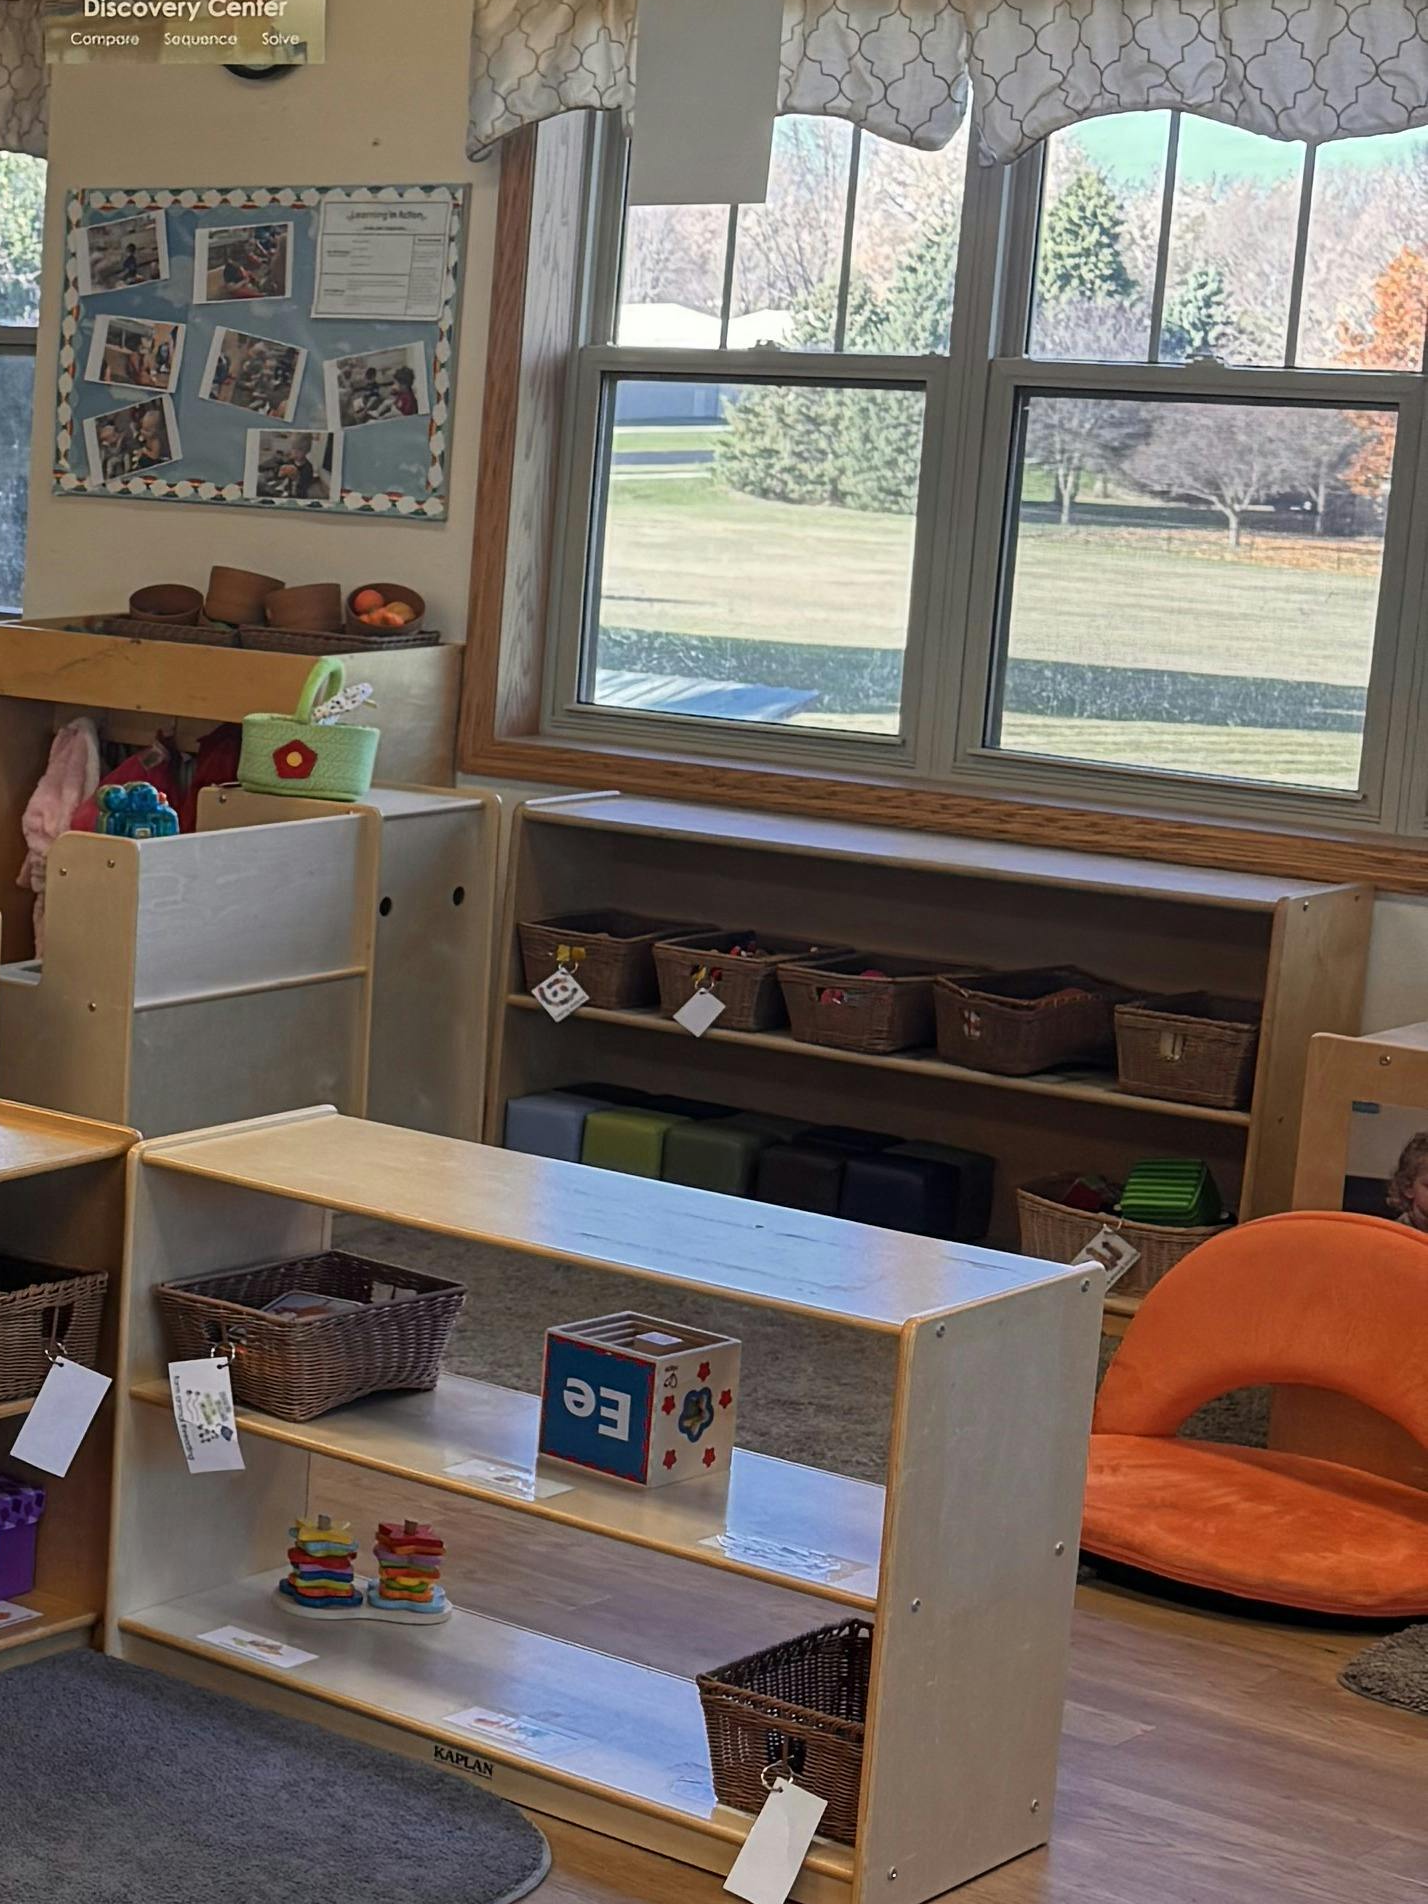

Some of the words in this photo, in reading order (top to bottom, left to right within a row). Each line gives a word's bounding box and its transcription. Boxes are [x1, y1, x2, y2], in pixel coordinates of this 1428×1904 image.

[70, 31, 140, 47] Compare
[163, 31, 238, 47] Sequence
[261, 31, 301, 46] Solve
[433, 1746, 493, 1777] KAPLAN
